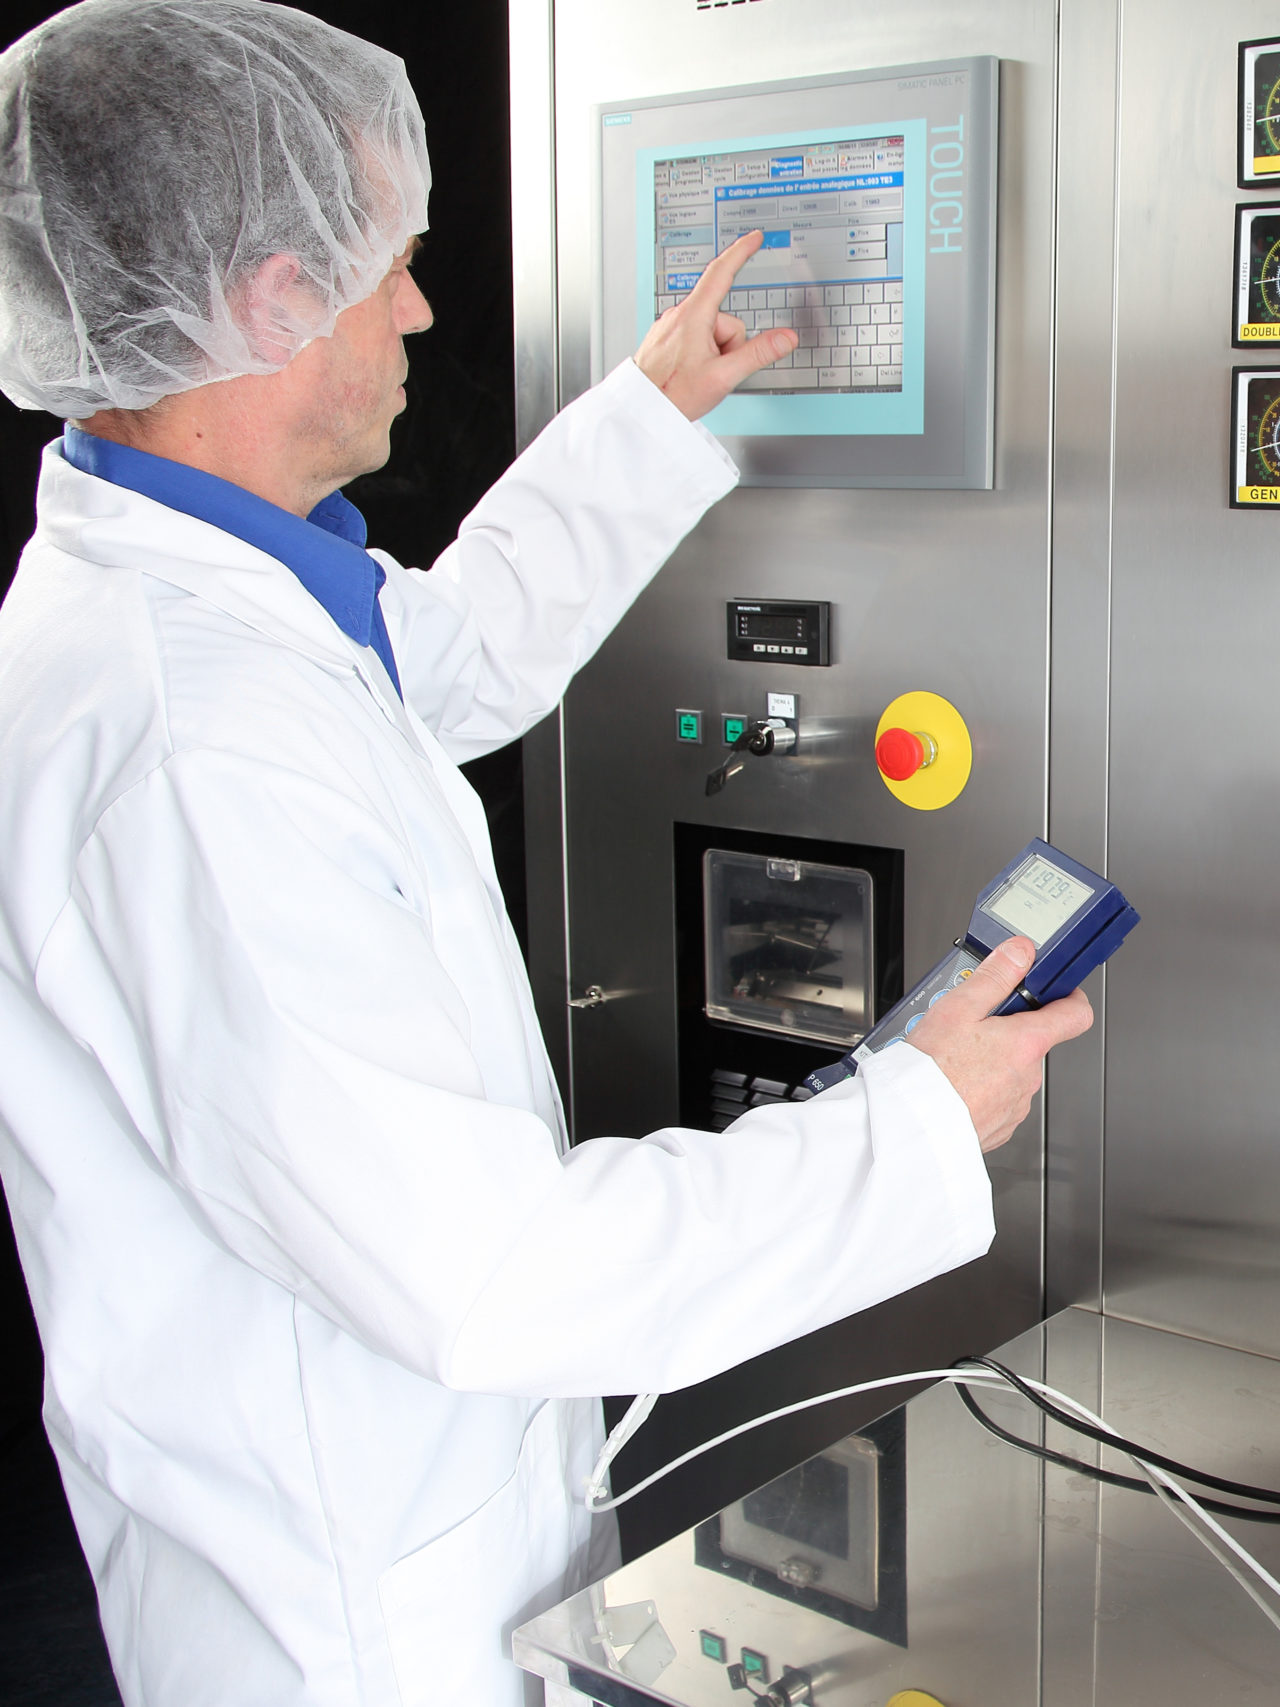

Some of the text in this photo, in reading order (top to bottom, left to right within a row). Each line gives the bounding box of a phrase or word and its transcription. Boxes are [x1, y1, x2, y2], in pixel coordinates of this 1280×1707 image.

[728, 188, 757, 198] Calibrage
[758, 186, 784, 194] données
[821, 180, 855, 190] analogique
[930, 114, 964, 254] TOUCH
[812, 1079, 824, 1090] 650
